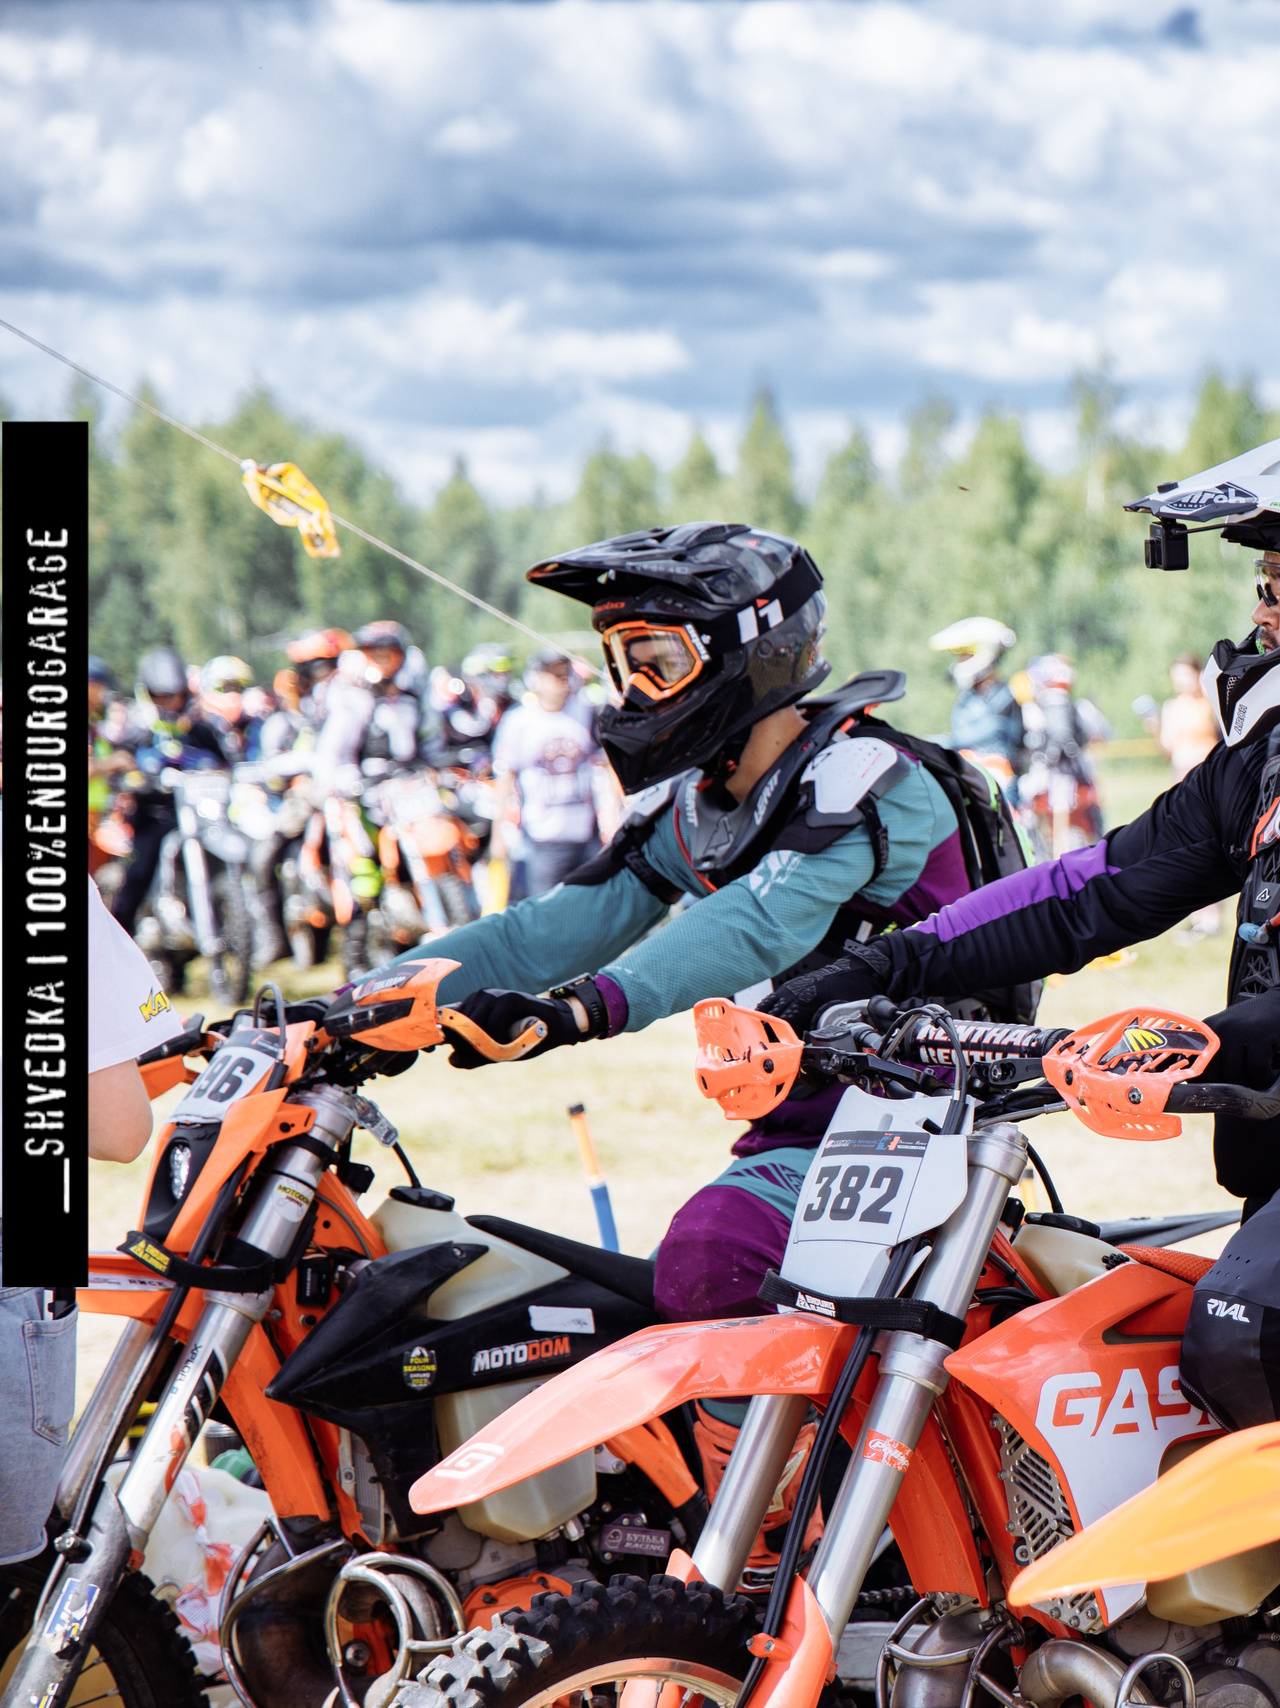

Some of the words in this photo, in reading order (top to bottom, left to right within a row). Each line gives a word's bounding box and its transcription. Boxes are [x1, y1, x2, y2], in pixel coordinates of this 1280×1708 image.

[753, 768, 781, 826] LEATT
[919, 1046, 1028, 1066] RENTH
[192, 1054, 255, 1103] 96
[803, 1164, 904, 1225] 382
[1206, 1298, 1250, 1323] RIVAL
[472, 1335, 572, 1374] MOTODOM
